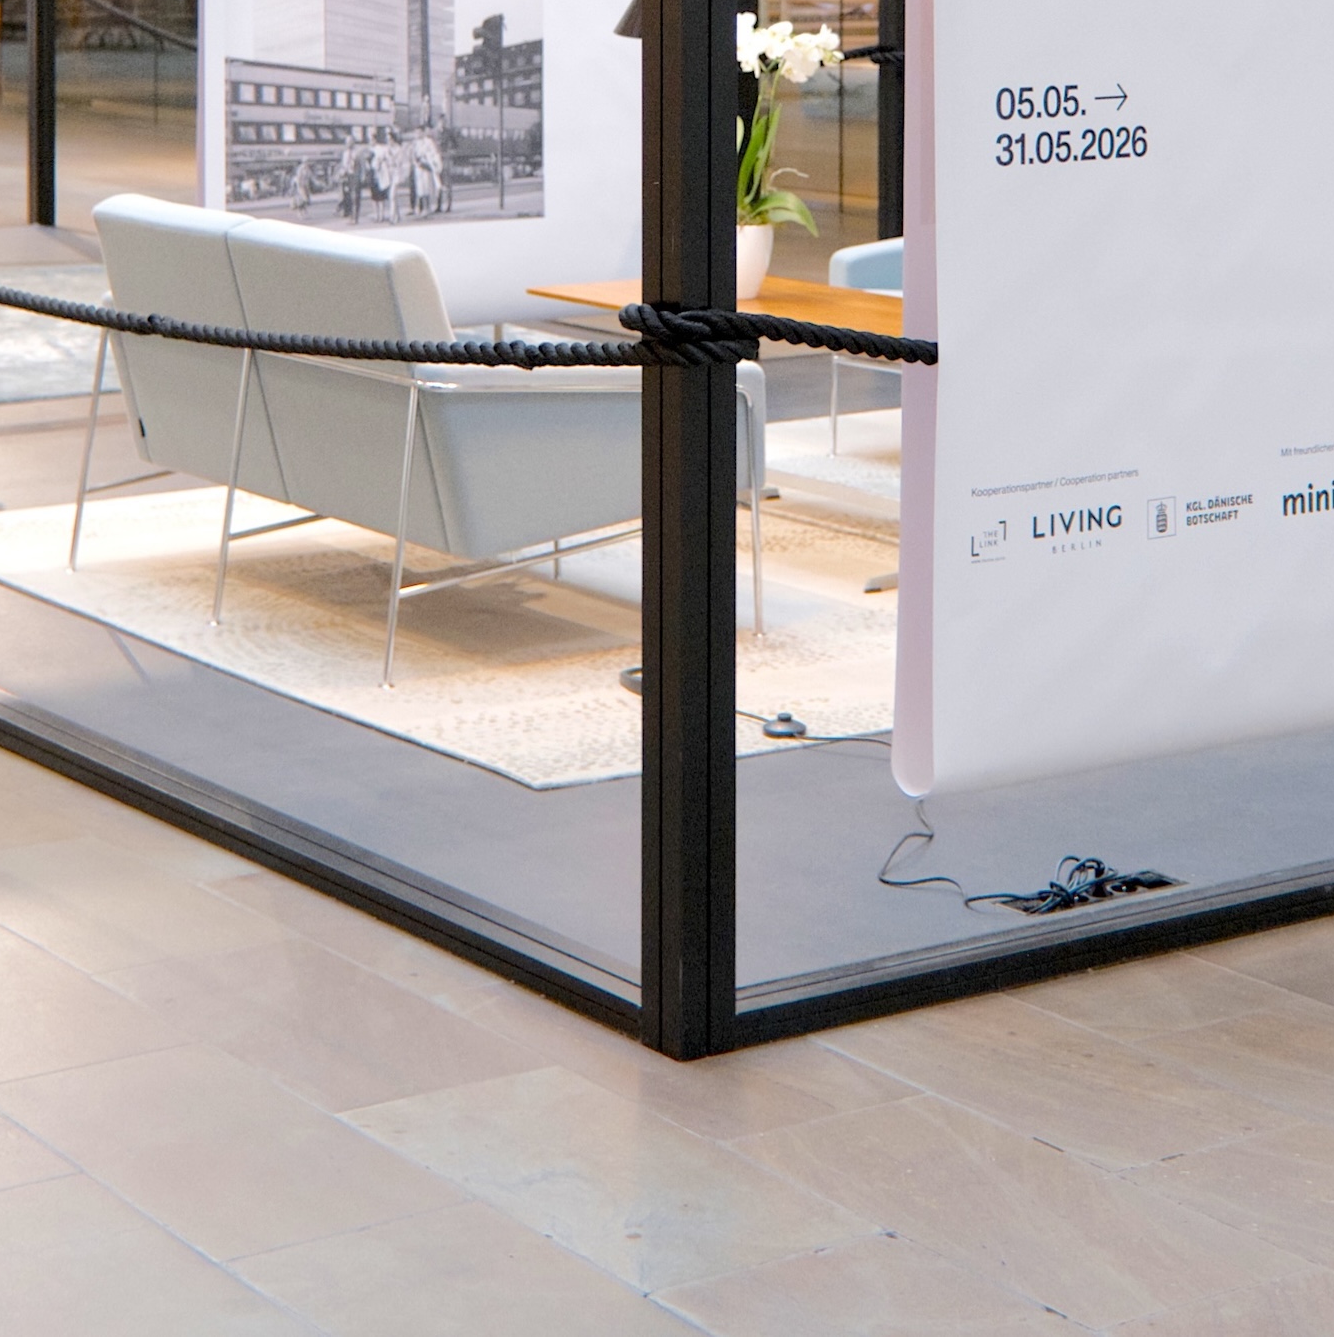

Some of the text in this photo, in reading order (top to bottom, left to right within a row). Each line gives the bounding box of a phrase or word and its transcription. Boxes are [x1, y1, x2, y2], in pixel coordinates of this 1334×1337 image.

[995, 84, 1087, 121] 05.05.
[995, 125, 1147, 166] 31.05.2026
[1294, 443, 1334, 455] freundlicher
[971, 468, 1139, 498] Kooperationspartner Cooperation partners
[1186, 494, 1254, 512] KGL. DÄNISCHE
[1033, 505, 1123, 538] LIVING
[1186, 510, 1239, 526] BOTSCHAFT
[979, 539, 998, 548] LINK
